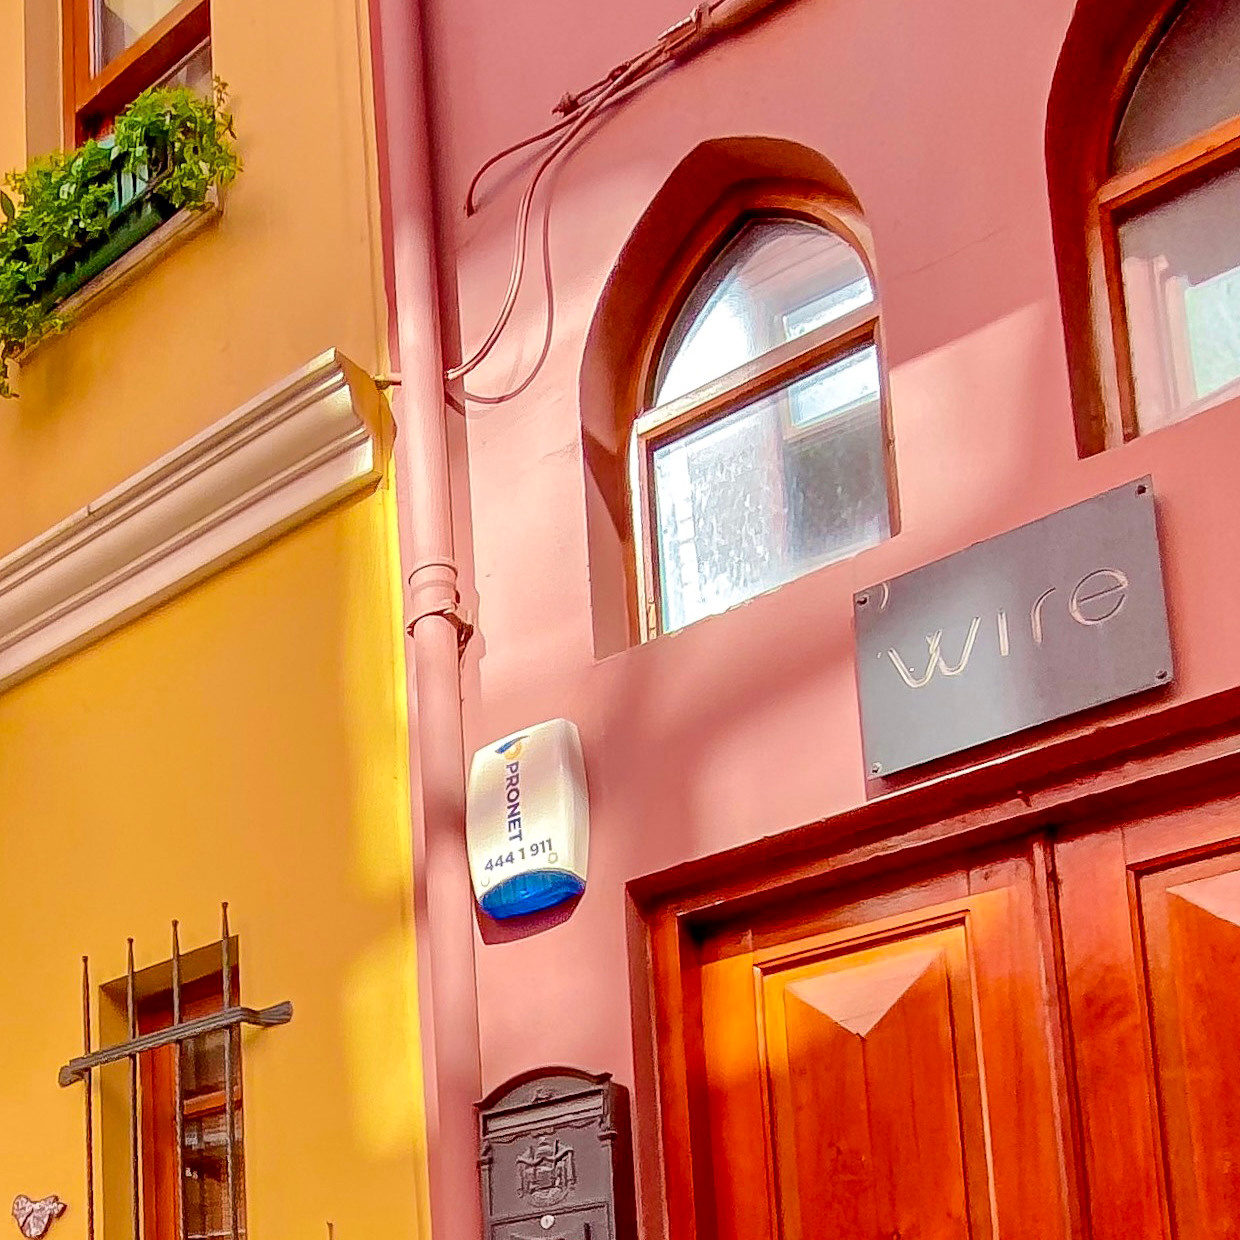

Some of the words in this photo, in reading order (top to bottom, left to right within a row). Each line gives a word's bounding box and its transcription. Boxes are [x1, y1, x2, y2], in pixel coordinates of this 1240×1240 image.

[505, 760, 523, 842] PRONET
[484, 851, 515, 871] 444
[517, 847, 526, 860] 1
[529, 838, 553, 857] 911
